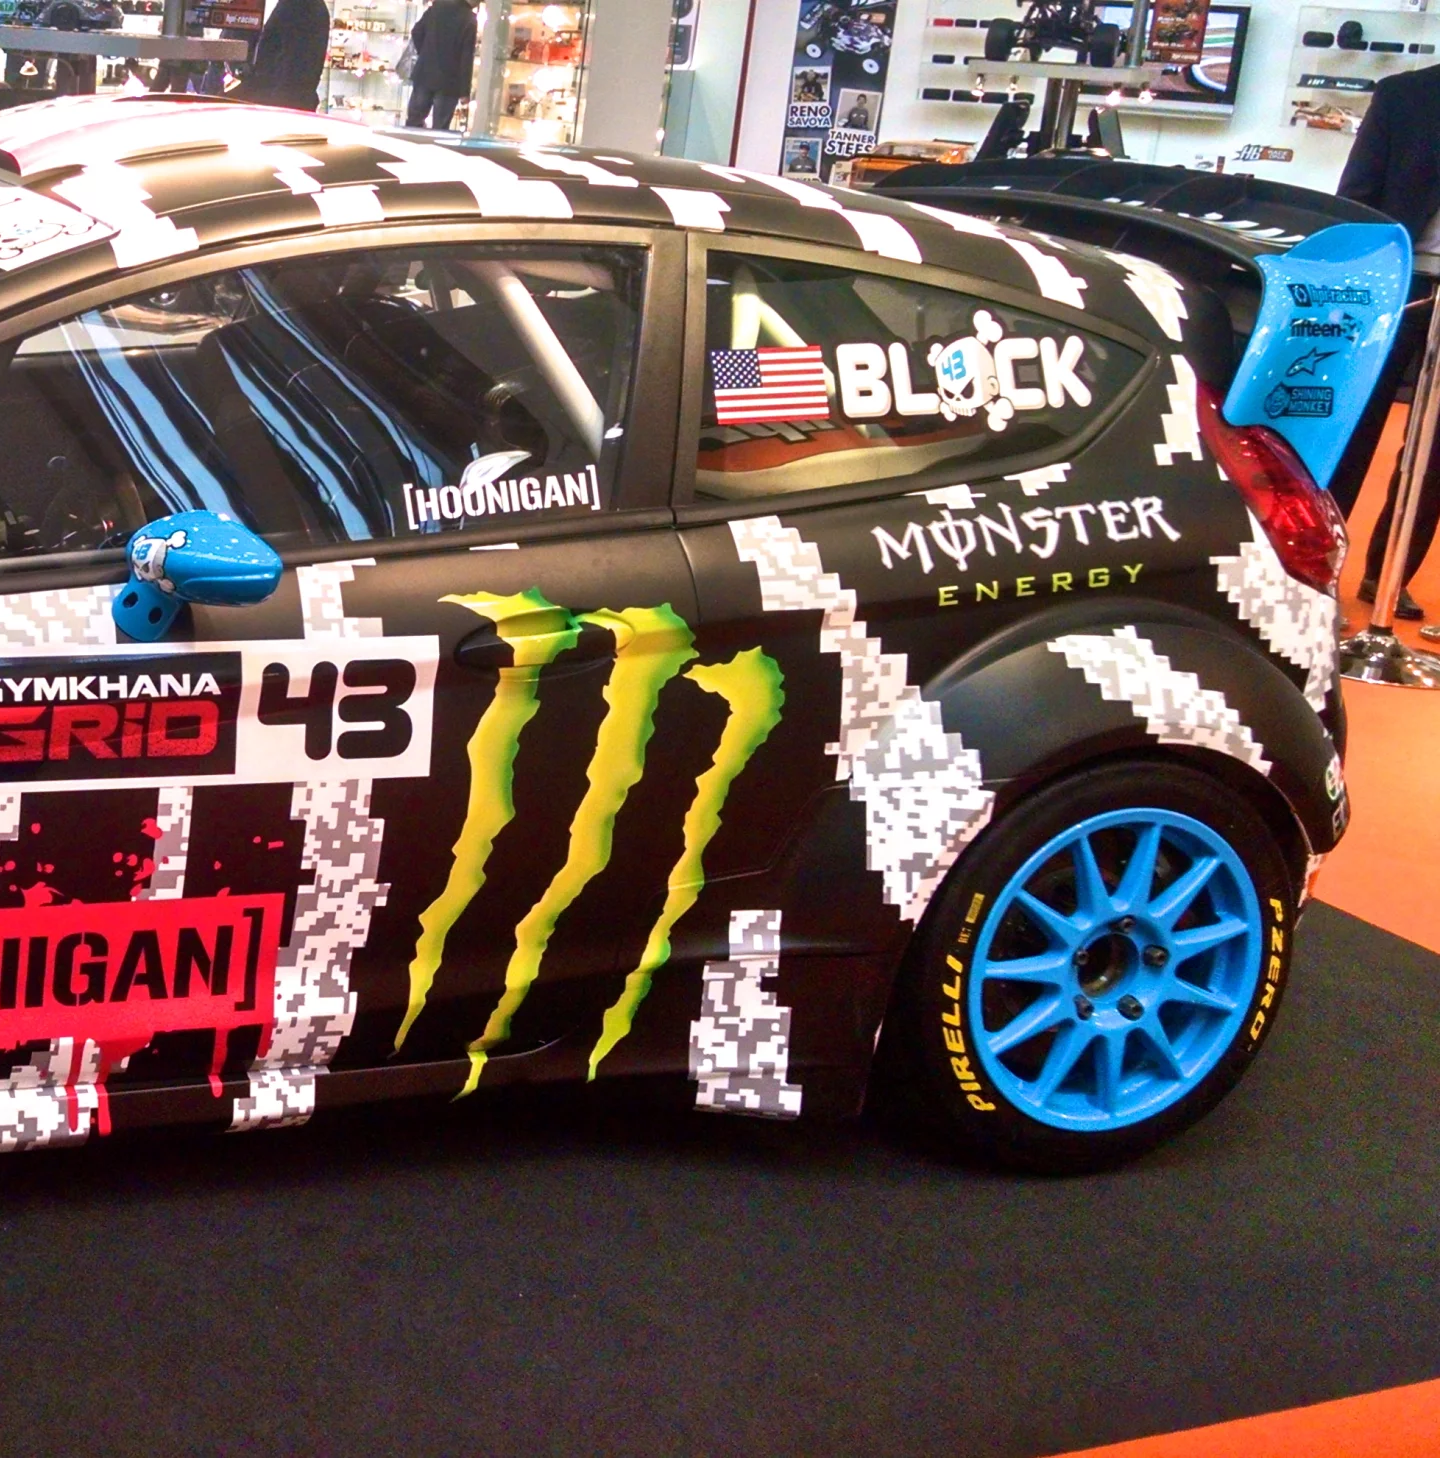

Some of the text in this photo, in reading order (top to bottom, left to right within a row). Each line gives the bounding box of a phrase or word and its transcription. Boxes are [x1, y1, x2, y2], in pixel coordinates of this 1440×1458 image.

[790, 105, 831, 117] RENO
[789, 117, 831, 126] SAVOYA
[830, 130, 875, 144] TANNER
[941, 348, 969, 383] 43
[1290, 387, 1333, 401] SHINING
[1288, 400, 1331, 414] MONKEY
[937, 561, 1145, 608] ENERGY
[256, 657, 419, 762] 43
[942, 954, 997, 1113] PIRELLI
